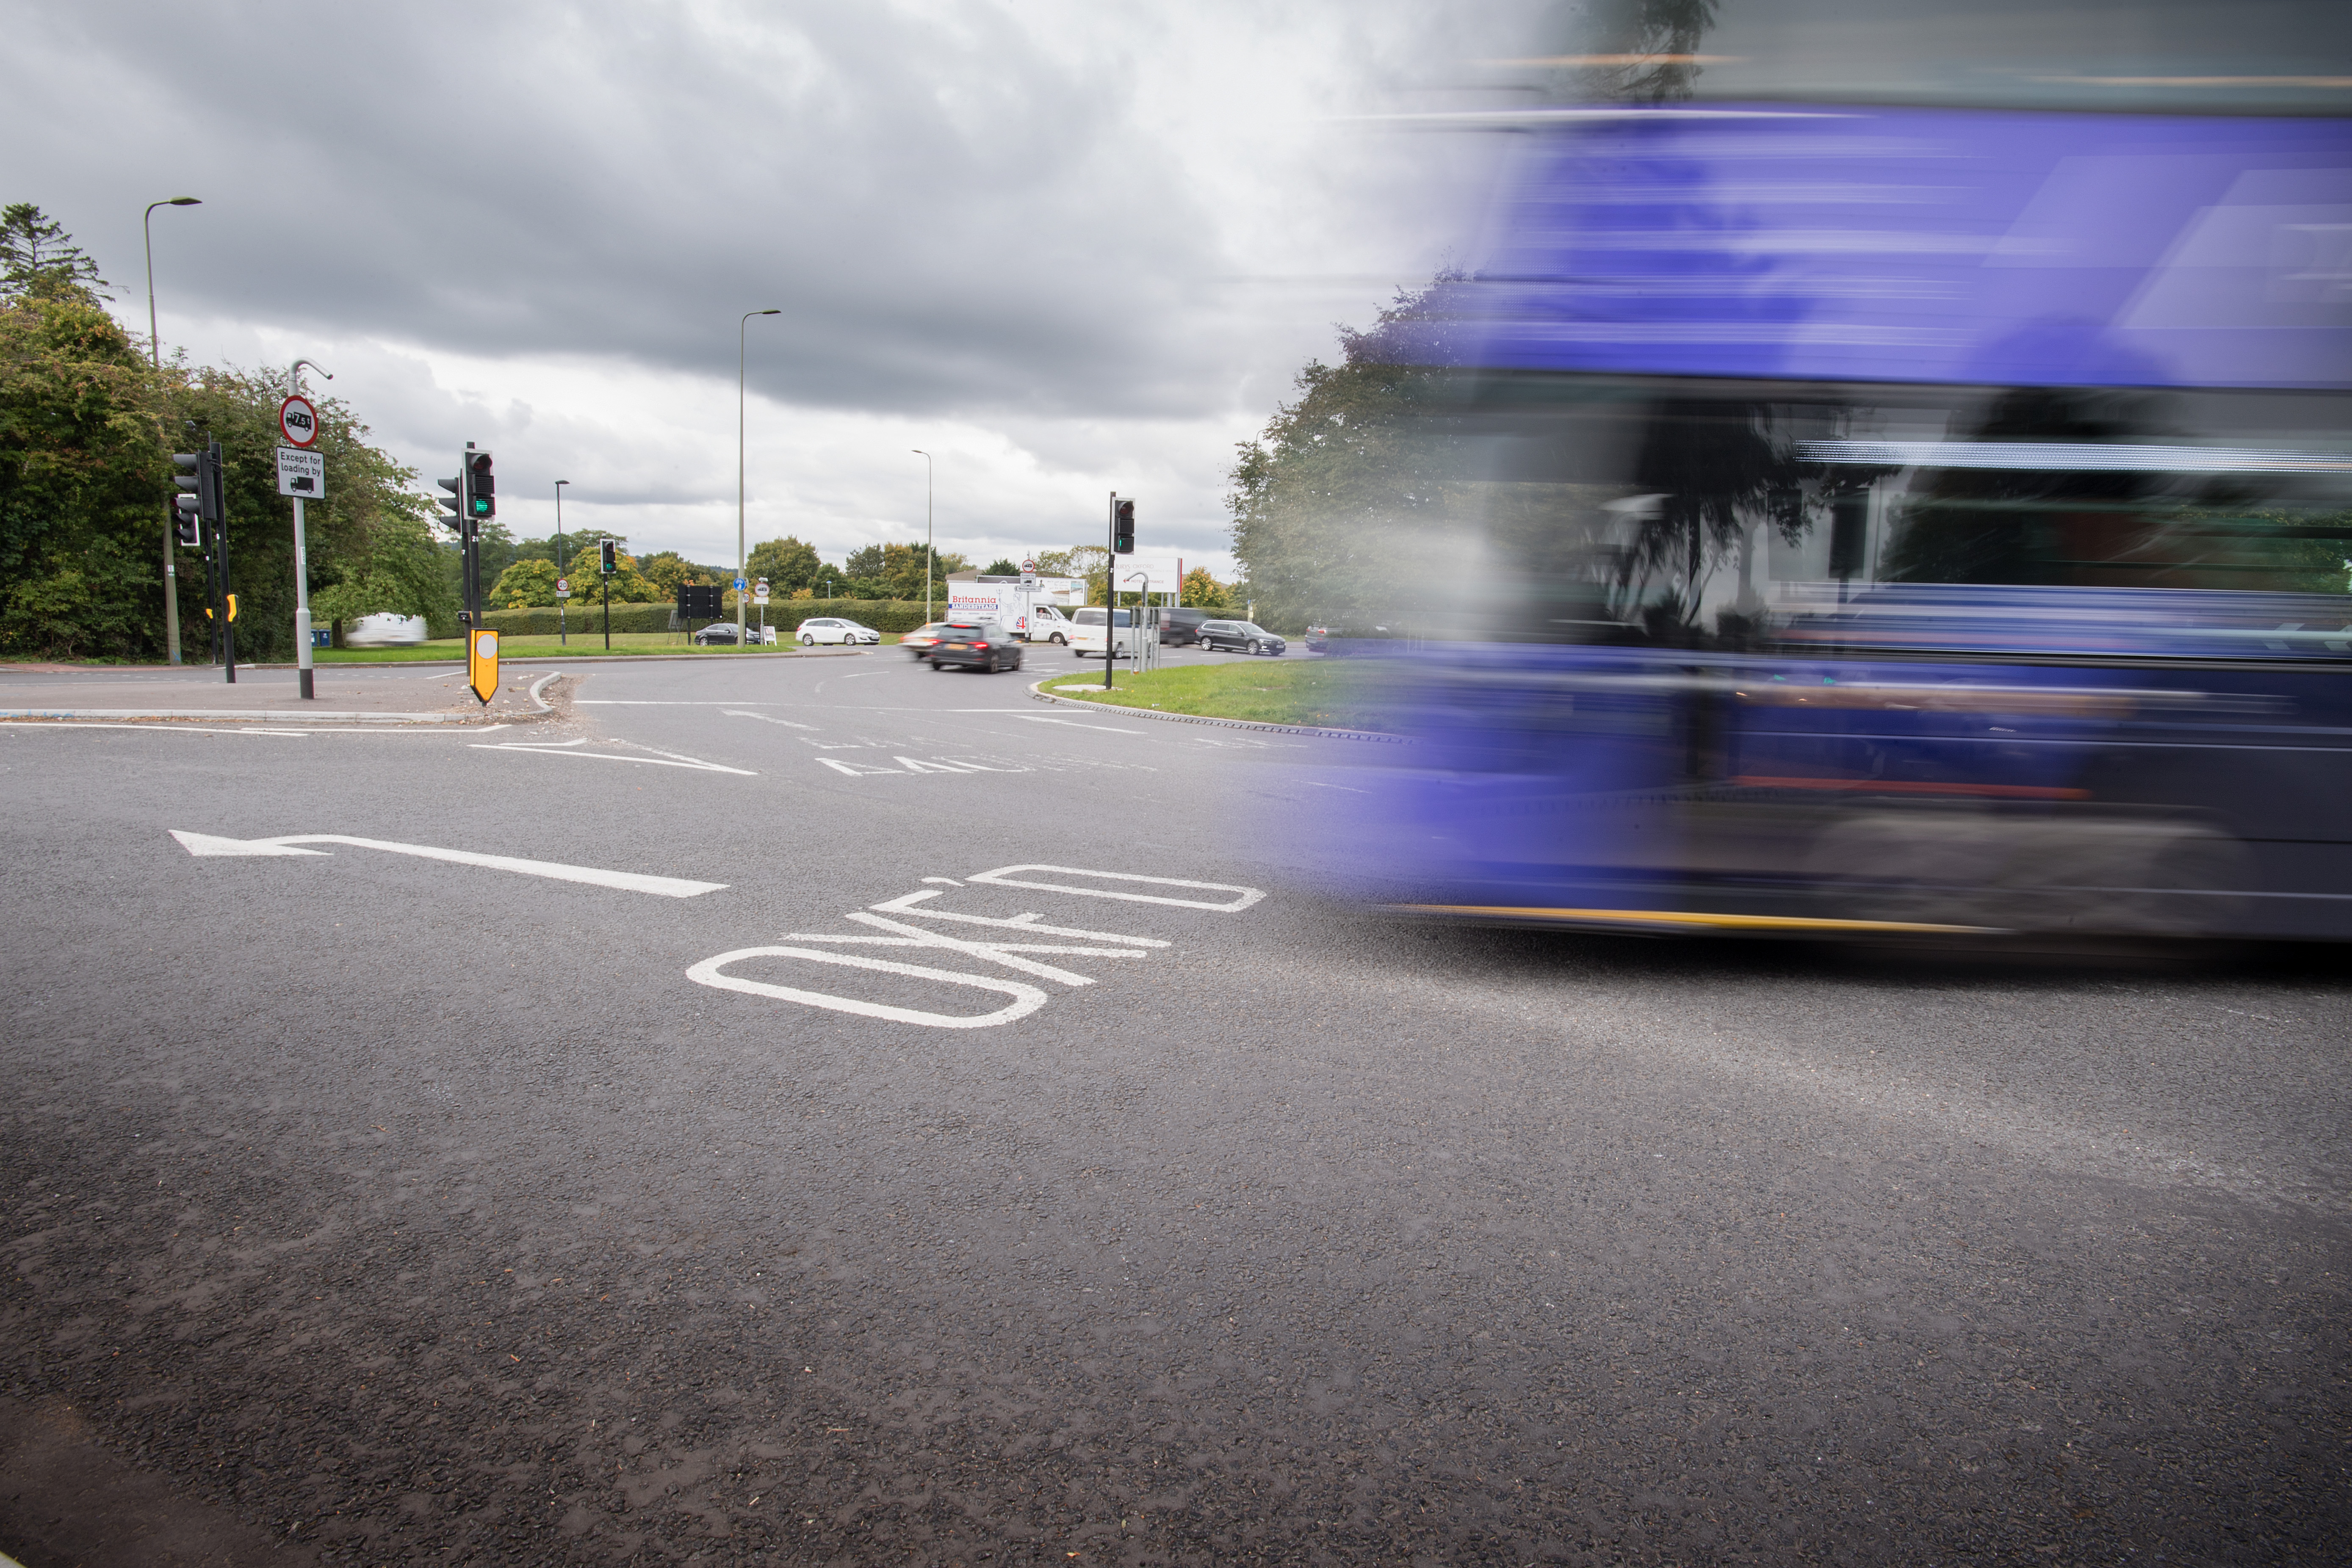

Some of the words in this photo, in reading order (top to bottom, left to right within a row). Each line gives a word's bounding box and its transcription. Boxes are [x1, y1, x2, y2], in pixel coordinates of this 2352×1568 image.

[280, 452, 307, 464] Except
[310, 456, 321, 465] for
[281, 463, 310, 476] loading
[312, 467, 321, 477] by
